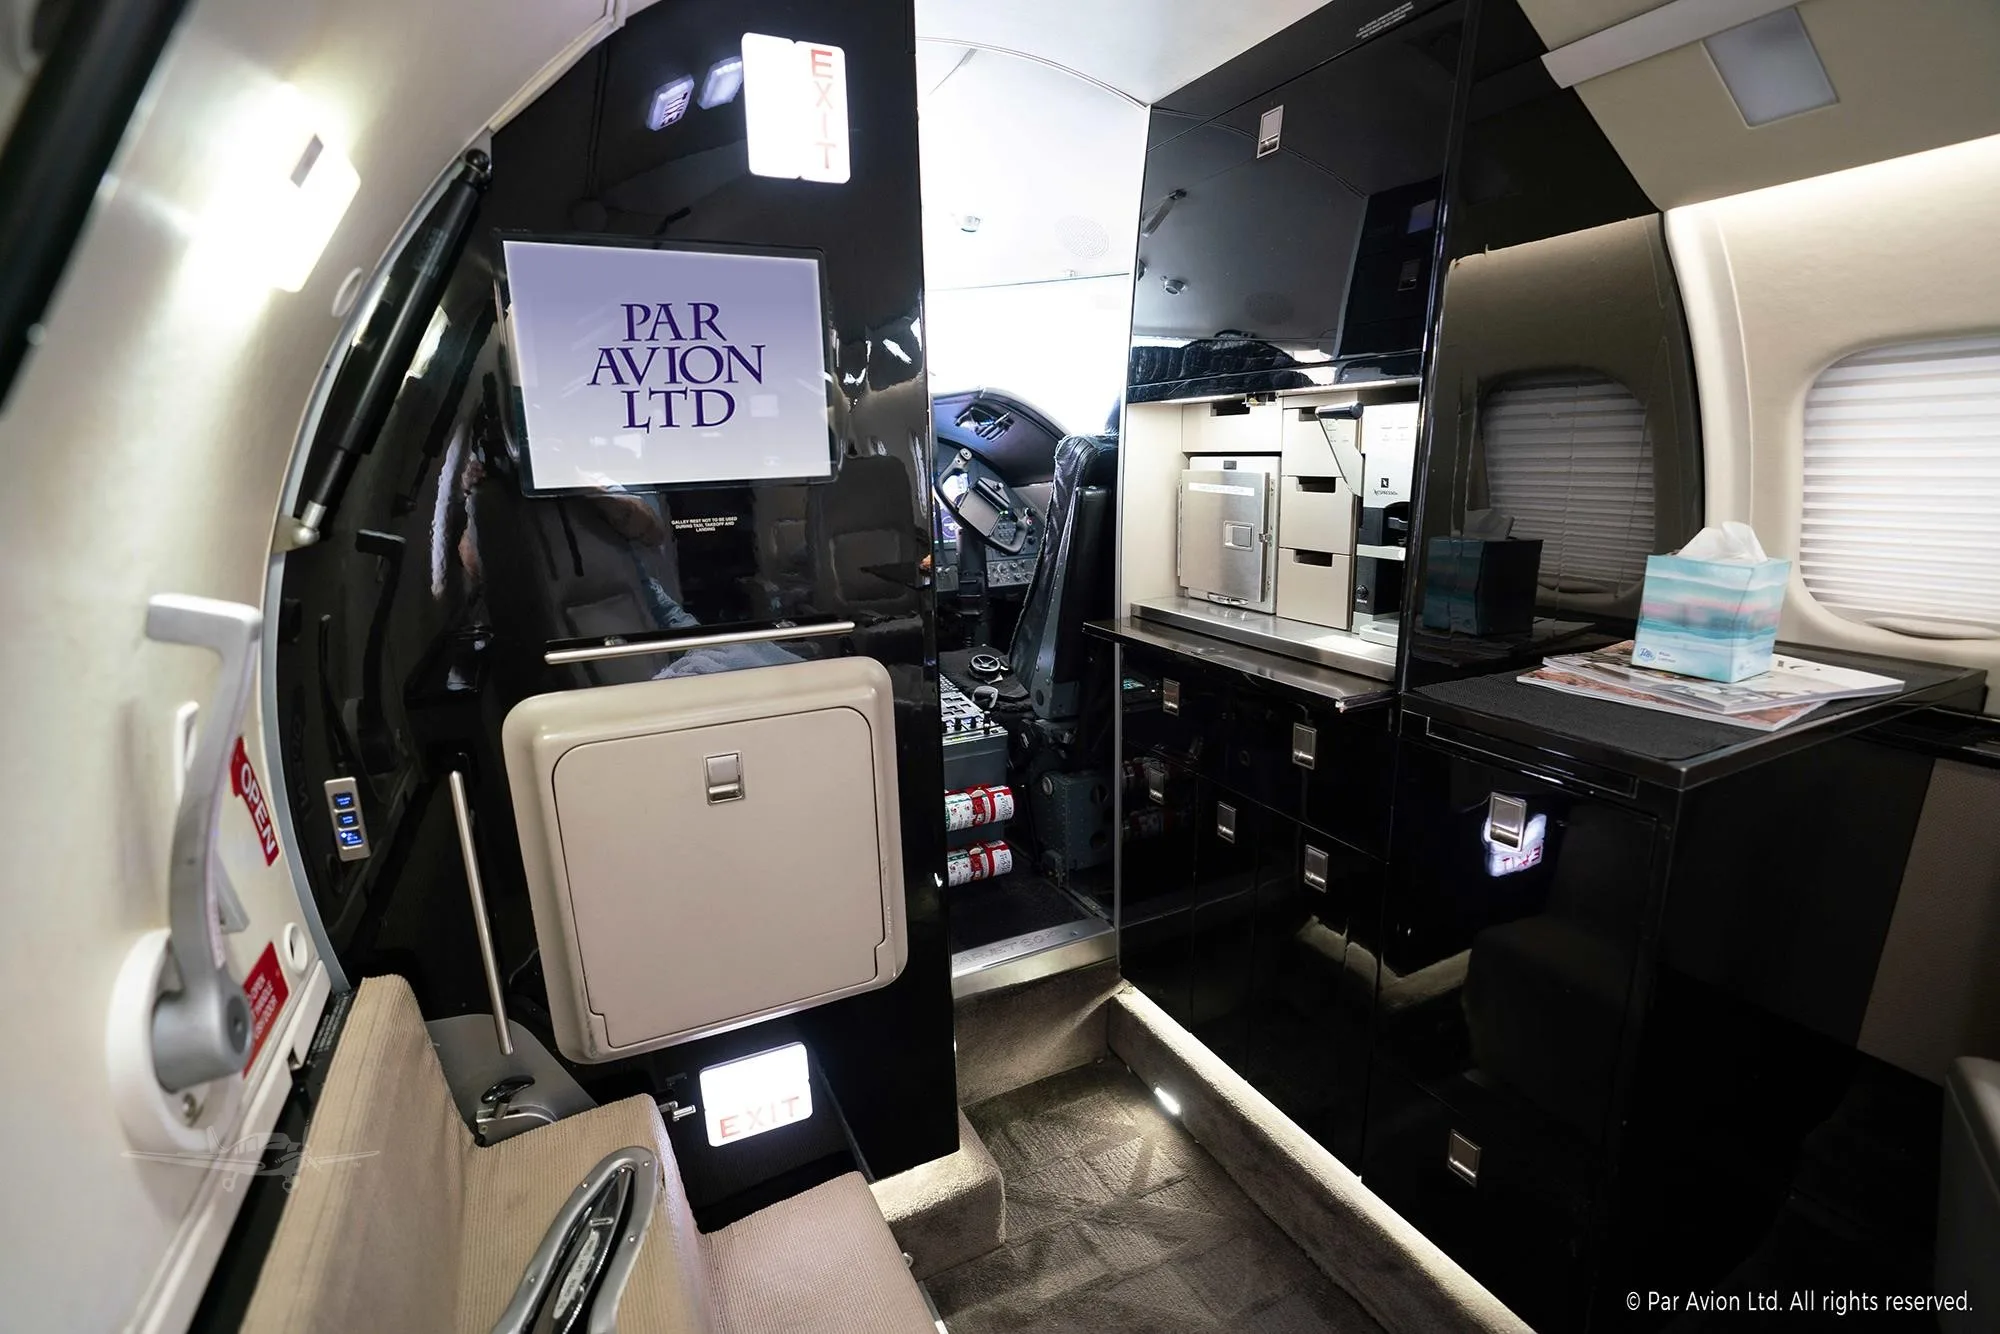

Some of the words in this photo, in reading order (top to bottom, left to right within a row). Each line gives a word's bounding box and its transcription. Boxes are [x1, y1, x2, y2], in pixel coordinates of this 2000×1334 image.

[811, 48, 836, 169] EXIT
[620, 302, 727, 342] PAR
[586, 345, 766, 386] AVION
[621, 386, 736, 434] LTD
[241, 763, 277, 855] OPEN
[720, 1096, 799, 1138] EXIT
